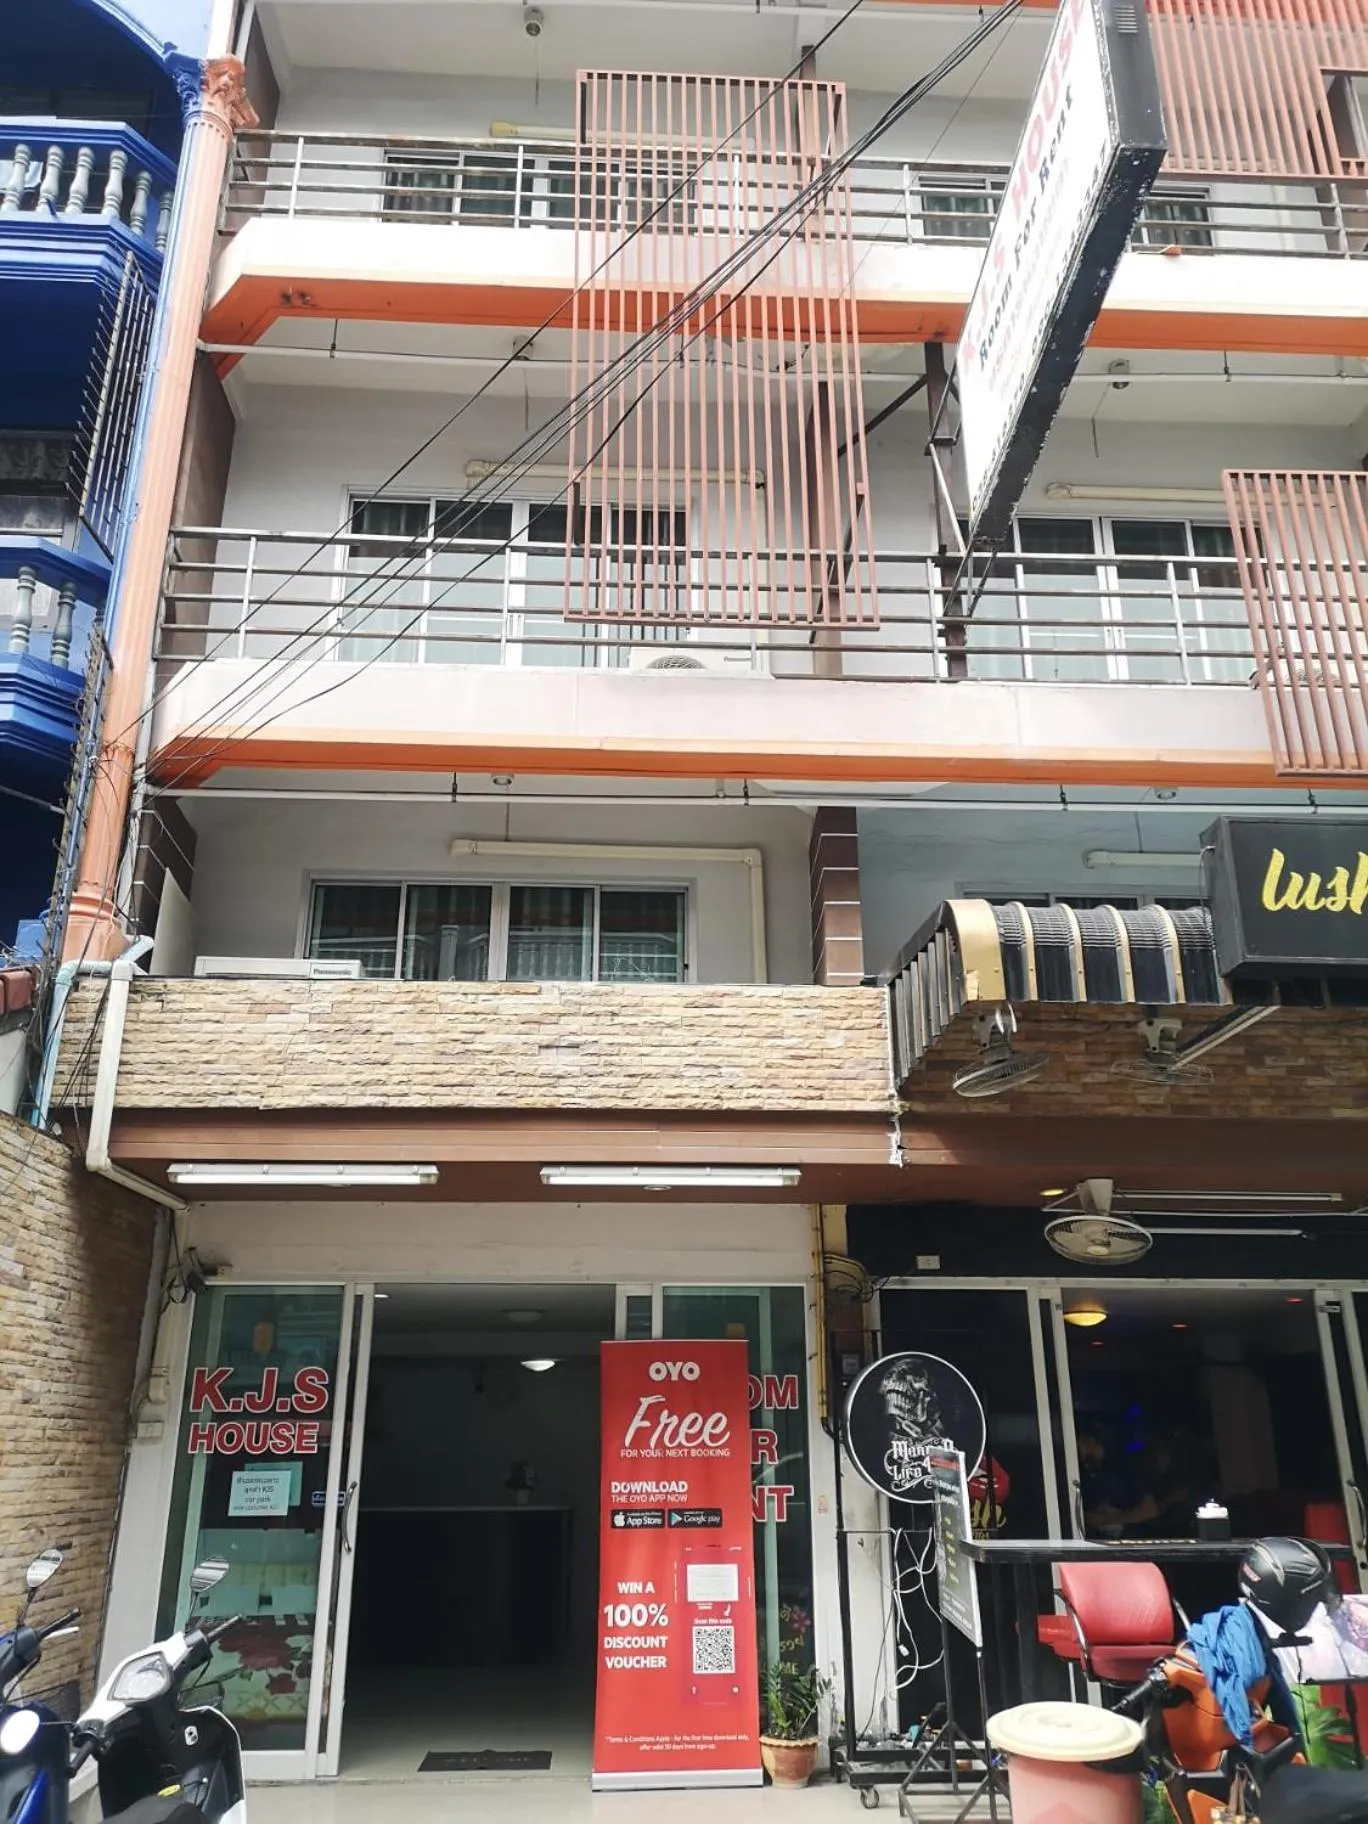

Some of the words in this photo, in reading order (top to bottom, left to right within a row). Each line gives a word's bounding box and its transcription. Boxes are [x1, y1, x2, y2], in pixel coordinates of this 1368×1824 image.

[979, 272, 1012, 372] Room
[1014, 195, 1037, 270] For
[1039, 82, 1073, 195] Rent
[649, 1361, 700, 1381] OYO
[189, 1366, 329, 1413] K.J.S
[624, 1394, 731, 1449] Free
[188, 1421, 320, 1455] HOUSE
[620, 1448, 638, 1458] FOR
[640, 1448, 664, 1458] YOUR
[666, 1448, 689, 1458] NEXT
[691, 1448, 731, 1458] BOOKING
[611, 1481, 688, 1493] DOWNLOAD
[611, 1494, 628, 1503] THE
[630, 1494, 647, 1503] OYO
[649, 1494, 666, 1503] APP
[667, 1494, 688, 1503] NOW
[627, 1517, 642, 1527] App
[643, 1516, 662, 1525] Store
[683, 1515, 706, 1524] Google
[617, 1582, 643, 1594] WIN
[645, 1581, 655, 1593] A
[603, 1603, 669, 1627] 100%
[604, 1636, 668, 1649] DISCOUNT
[605, 1655, 667, 1669] VOUCHER
